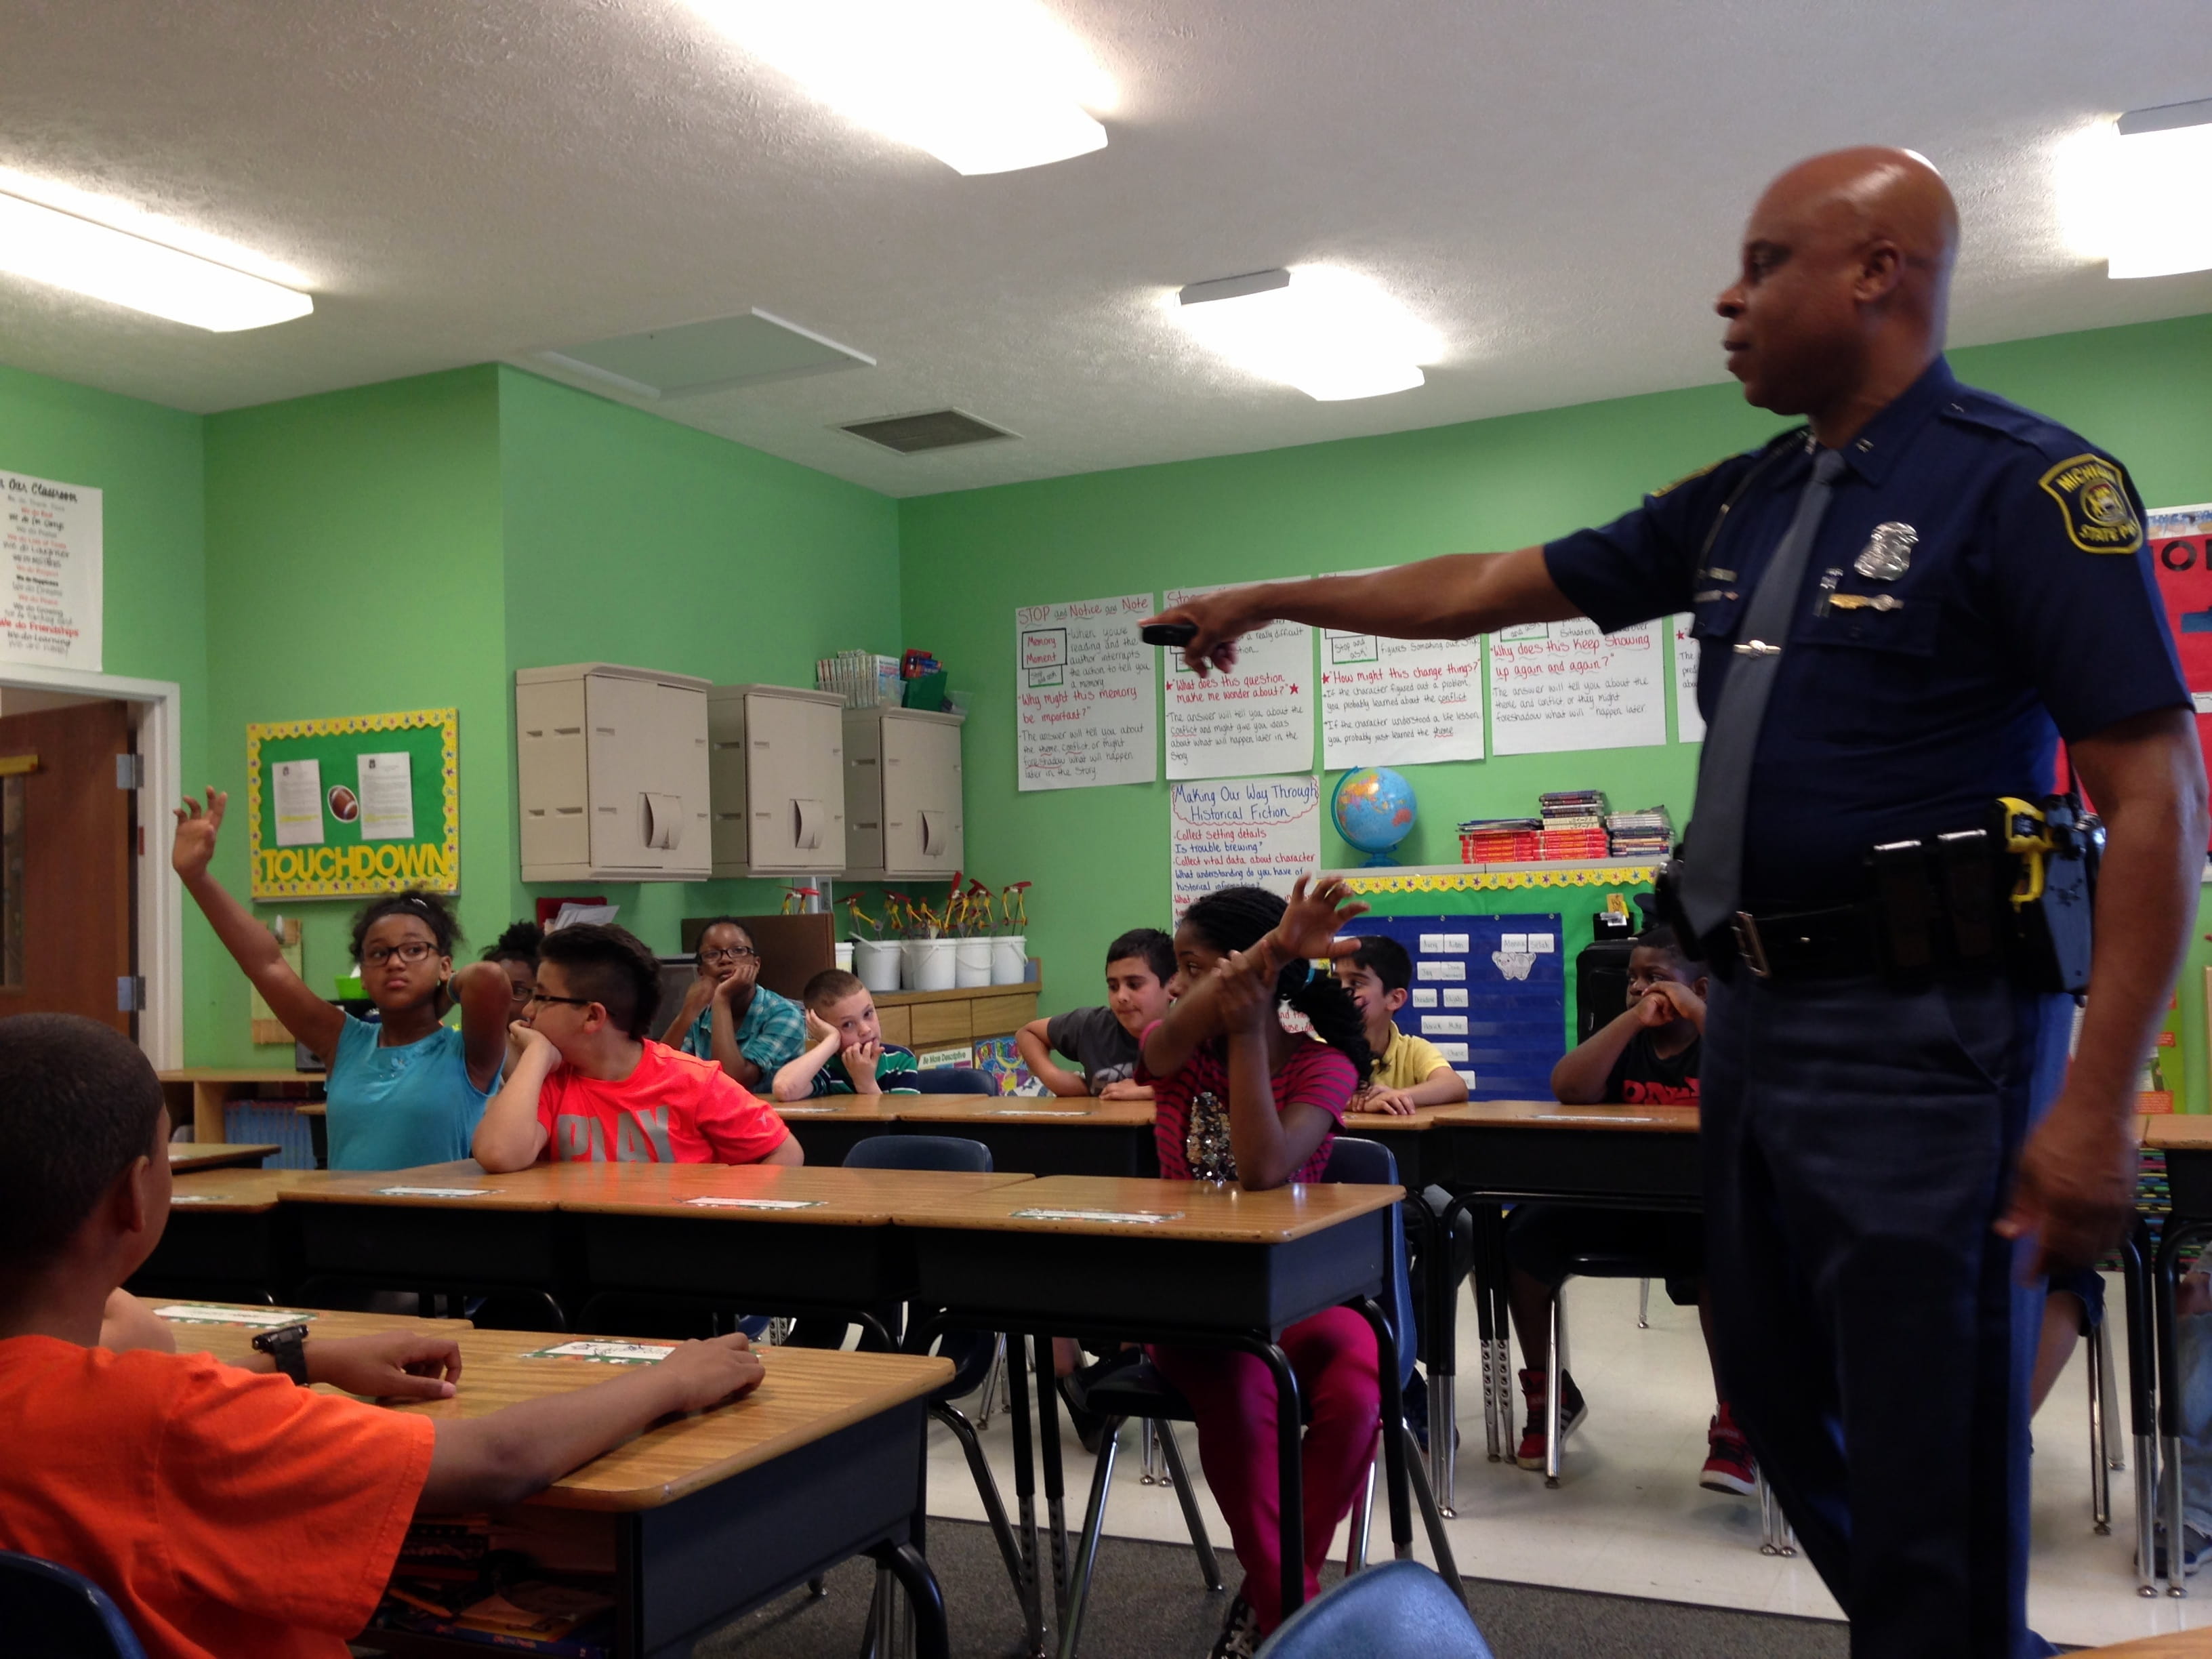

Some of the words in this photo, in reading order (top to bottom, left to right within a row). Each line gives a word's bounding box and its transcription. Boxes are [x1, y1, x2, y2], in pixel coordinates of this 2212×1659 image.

[31, 483, 79, 503] Classroom
[1019, 606, 1050, 624] STOP
[1069, 603, 1102, 617] Notice
[1122, 598, 1148, 610] Note
[30, 623, 79, 637] Friendships
[1255, 630, 1273, 642] really
[1275, 624, 1304, 637] difficult
[1027, 636, 1057, 648] Memory
[1071, 640, 1102, 653] reading
[1105, 638, 1119, 649] and
[1124, 637, 1138, 647] the
[1353, 638, 1365, 648] and
[1518, 643, 1542, 655] does
[1547, 640, 1570, 652] this
[1381, 644, 1407, 656] figures
[1680, 651, 1694, 660] The
[1025, 655, 1057, 664] Moment
[1069, 653, 1097, 665] author
[1101, 651, 1141, 661] interrupts
[1118, 663, 1132, 672] tell
[1136, 663, 1150, 674] you
[1357, 669, 1382, 684] might
[1389, 667, 1410, 678] this
[1414, 665, 1443, 682] change
[1496, 666, 1509, 681] up
[1514, 663, 1542, 679] again
[1548, 660, 1565, 674] and
[1080, 678, 1105, 689] memory
[1198, 678, 1218, 689] does
[1221, 676, 1240, 687] this
[1244, 673, 1285, 688] question
[1513, 685, 1544, 695] answer
[1549, 683, 1564, 693] will
[1568, 682, 1580, 691] tell
[1584, 680, 1600, 695] you
[1605, 678, 1630, 687] about
[1635, 677, 1649, 686] the
[1044, 692, 1068, 708] might
[1073, 690, 1095, 701] this
[1099, 687, 1137, 701] memory
[1177, 691, 1204, 703] make
[1208, 691, 1220, 701] me
[1223, 689, 1250, 699] wonder
[1339, 687, 1350, 697] the
[1353, 685, 1388, 696] character
[1391, 683, 1414, 695] figured
[1417, 683, 1429, 691] out
[1327, 702, 1340, 713] you
[1343, 699, 1369, 711] probably
[1373, 697, 1398, 708] learned
[1401, 697, 1420, 705] about
[1424, 695, 1435, 703] the
[1438, 693, 1467, 703] conflict
[1496, 698, 1517, 709] theme
[1521, 698, 1534, 708] and
[1538, 697, 1563, 707] conflict
[1578, 693, 1594, 707] they
[1598, 693, 1620, 707] might
[1023, 713, 1035, 724] be
[1187, 713, 1215, 722] answer
[1219, 710, 1232, 720] will
[1235, 708, 1246, 718] tell
[1248, 709, 1263, 720] you
[1267, 707, 1288, 716] about
[1292, 705, 1303, 714] the
[1340, 718, 1351, 728] the
[1355, 718, 1388, 727] character
[1392, 716, 1431, 726] understood
[1443, 712, 1454, 722] life
[1457, 711, 1479, 721] lesson
[1496, 710, 1542, 722] foreshadow
[1545, 709, 1566, 719] what
[1596, 706, 1622, 720] happen
[1626, 703, 1645, 714] later
[1040, 731, 1067, 740] answer
[1070, 729, 1083, 739] will
[1086, 727, 1098, 737] tell
[1101, 729, 1116, 740] you
[1120, 725, 1144, 735] about
[1214, 722, 1233, 735] might
[1237, 722, 1251, 732] give
[1254, 721, 1267, 732] you
[1270, 718, 1289, 728] ideas
[1171, 739, 1190, 747] about
[1193, 738, 1212, 747] what
[1216, 736, 1227, 745] will
[1230, 736, 1254, 745] happen
[1255, 733, 1271, 741] later
[1286, 731, 1297, 740] the
[1328, 735, 1342, 746] you
[1344, 731, 1372, 744] probably
[1374, 732, 1389, 743] just
[1392, 729, 1415, 740] learned
[1417, 728, 1429, 737] the
[1433, 726, 1454, 735] theme
[1103, 739, 1125, 751] might
[1069, 755, 1086, 764] what
[1090, 754, 1102, 762] will
[1106, 752, 1133, 762] happen
[1025, 769, 1041, 779] later
[1058, 766, 1072, 777] the
[1175, 785, 1216, 806] Making
[1221, 786, 1240, 801] Our
[1246, 783, 1269, 804] Way
[1271, 782, 1317, 804] Through
[1191, 806, 1243, 821] Historical
[1252, 804, 1290, 820] Fiction
[1206, 830, 1235, 842] setting
[1238, 827, 1267, 838] details
[1175, 844, 1187, 854] Is
[1190, 842, 1221, 853] trouble
[1225, 841, 1263, 854] brewing?
[260, 844, 449, 882] TOUCHDOWN
[1204, 855, 1223, 865] vital
[1227, 854, 1246, 865] data
[1250, 853, 1271, 864] about
[1275, 853, 1315, 863] character
[1175, 869, 1193, 879] What
[1196, 868, 1243, 880] understanding
[1246, 868, 1254, 877] do
[1257, 869, 1271, 880] you
[1295, 867, 1303, 876] of
[1176, 882, 1210, 892] historical
[942, 1052, 966, 1061] Descriptive
[558, 1105, 675, 1162] PLAY
